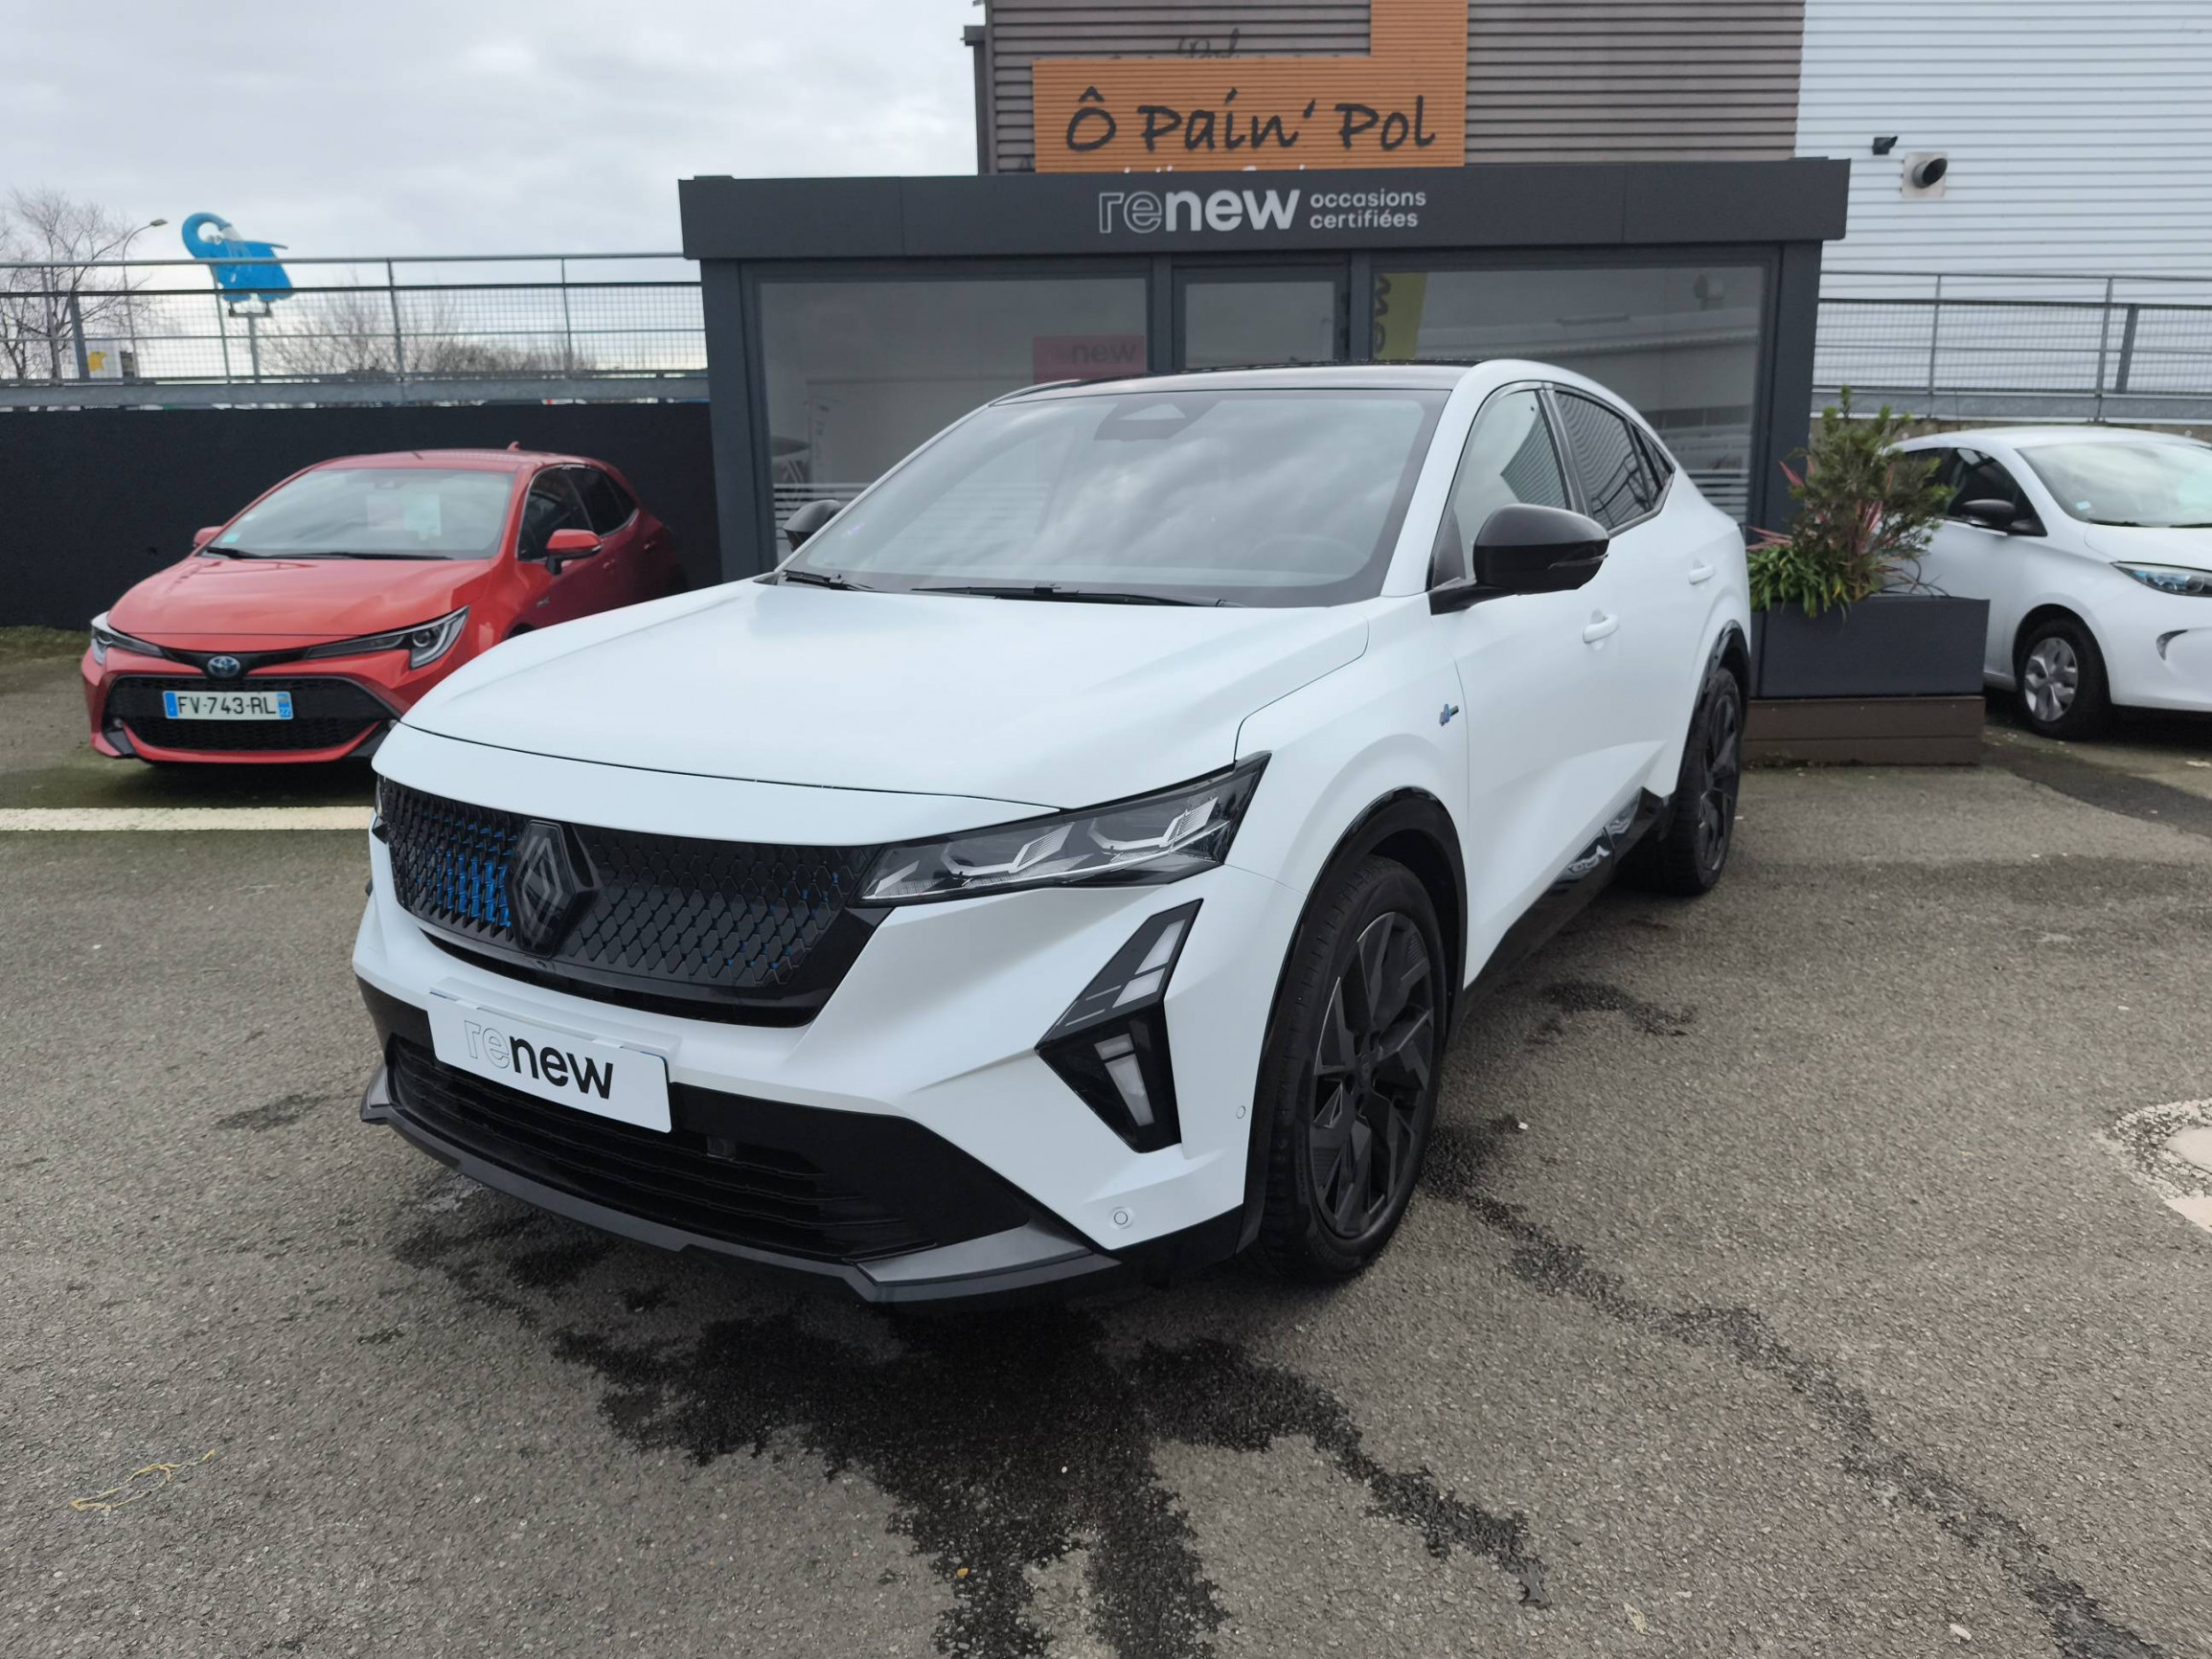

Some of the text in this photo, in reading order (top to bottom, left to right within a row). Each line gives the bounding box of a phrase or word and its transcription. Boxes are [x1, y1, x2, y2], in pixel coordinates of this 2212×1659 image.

[1065, 86, 1117, 151] Ô
[1335, 95, 1435, 151] Pol
[1098, 189, 1426, 235] renew occasions
[1310, 208, 1419, 230] certifiées
[177, 696, 277, 715] FV-743-RL
[464, 1019, 614, 1100] renew
